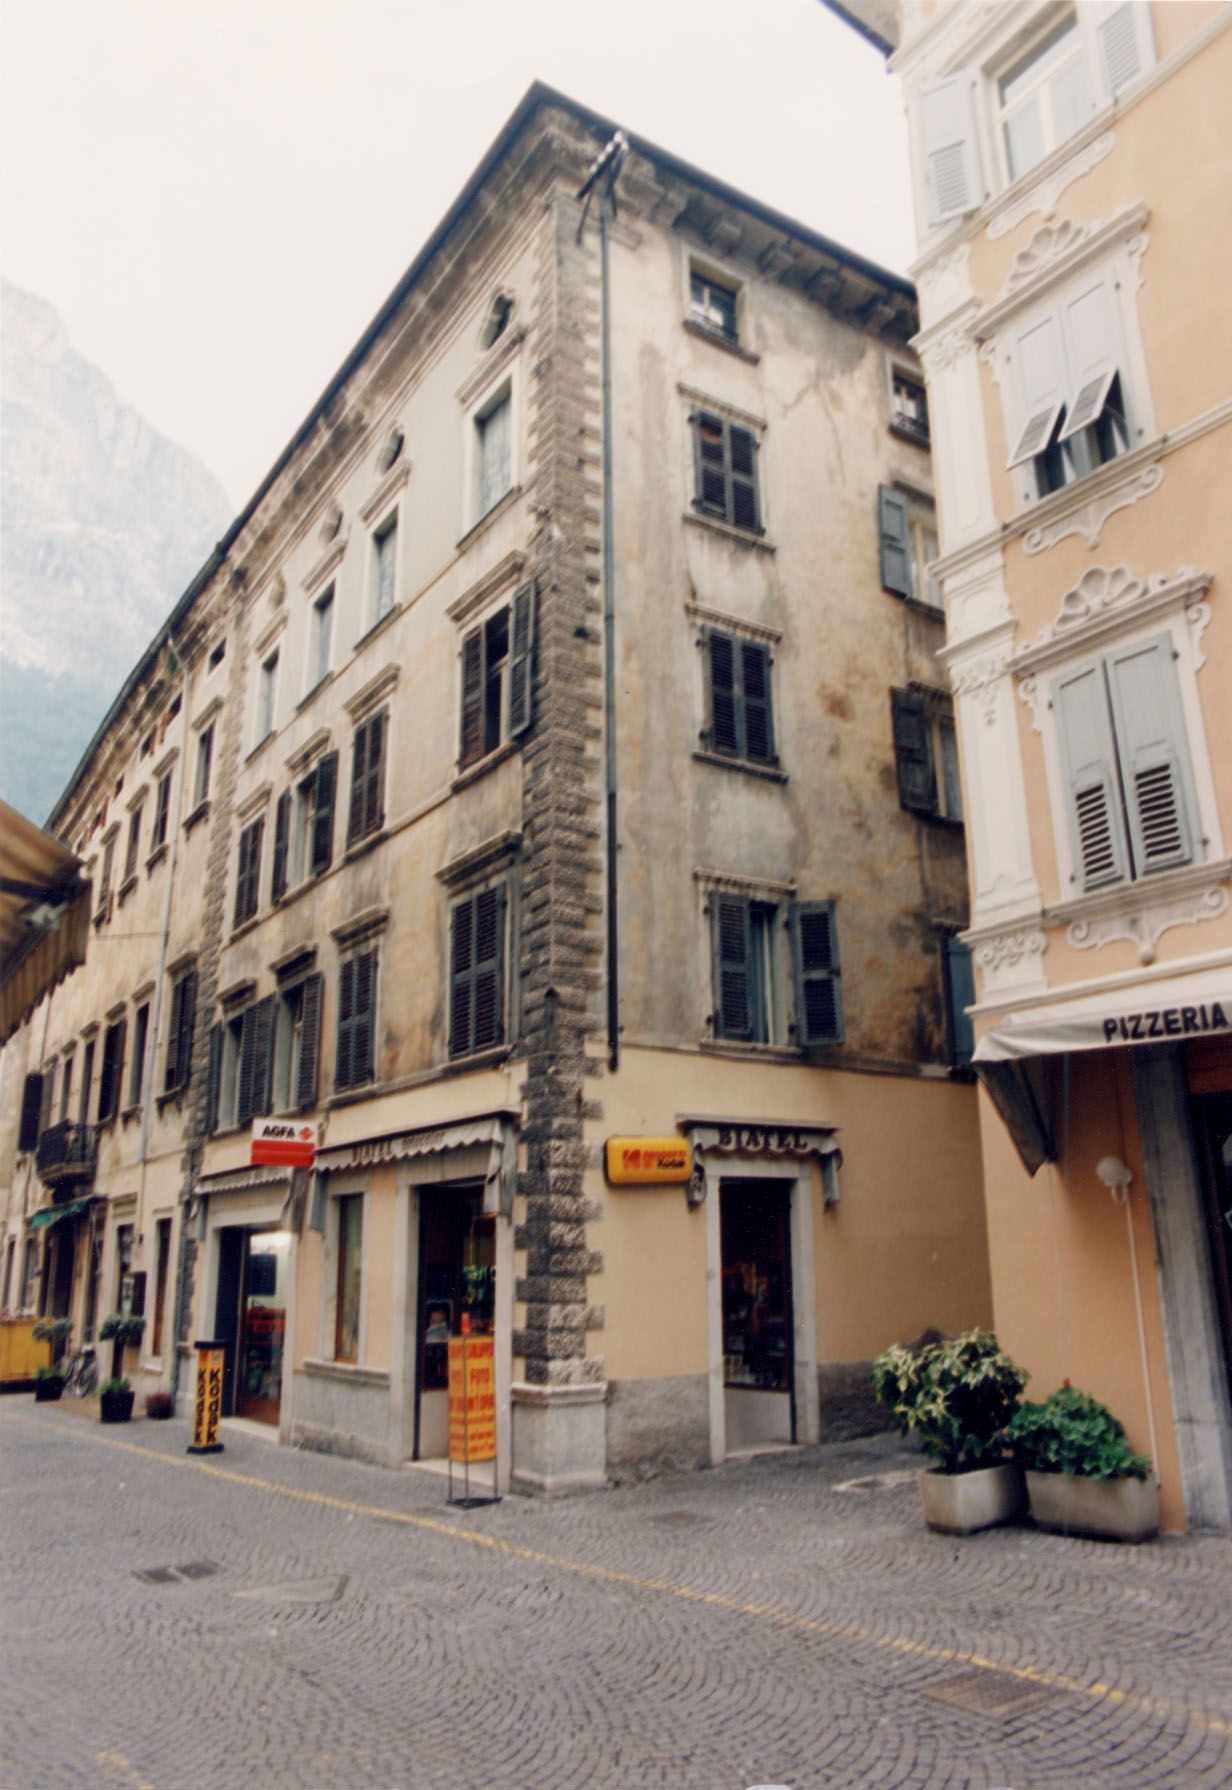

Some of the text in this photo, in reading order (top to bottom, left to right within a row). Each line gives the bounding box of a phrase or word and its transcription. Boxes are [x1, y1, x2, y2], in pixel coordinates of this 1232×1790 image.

[1103, 1002, 1228, 1043] PIZZERIA
[262, 1124, 296, 1138] AGFA
[718, 1128, 808, 1149] BIATEL
[194, 1367, 206, 1443] Kodak
[207, 1367, 221, 1443] Kodak
